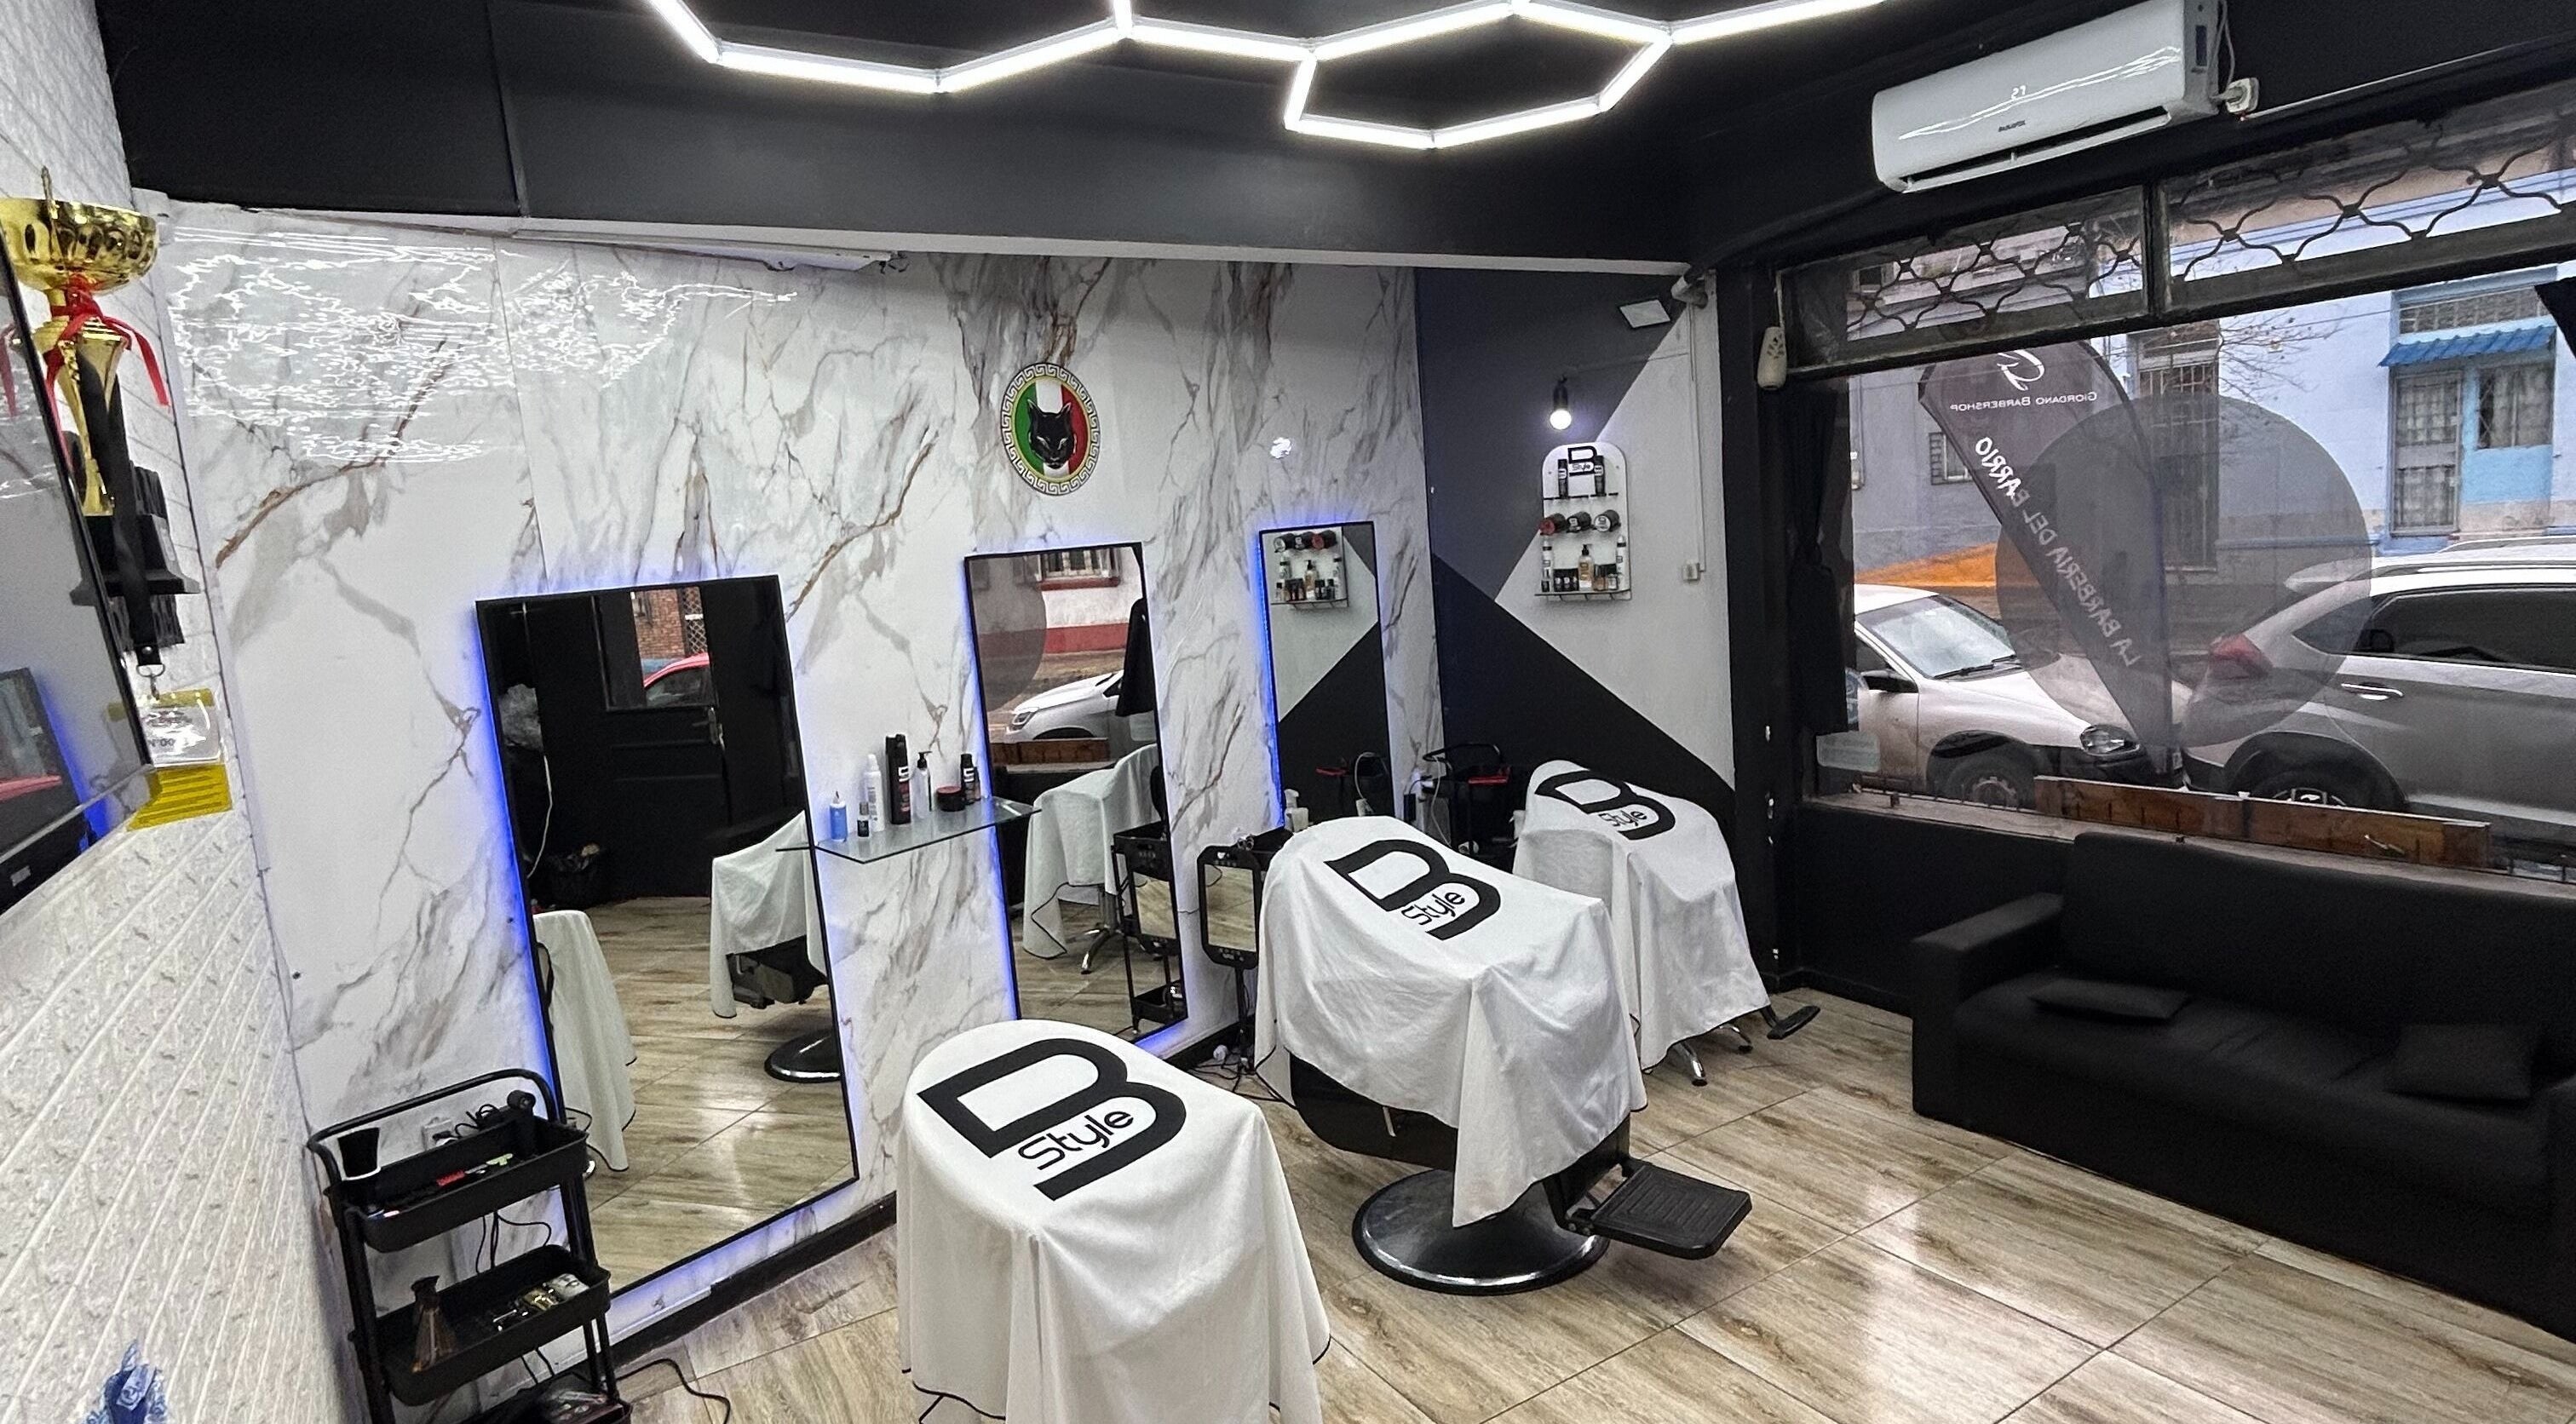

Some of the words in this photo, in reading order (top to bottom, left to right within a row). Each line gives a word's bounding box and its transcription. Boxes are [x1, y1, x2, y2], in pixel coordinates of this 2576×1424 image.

[1598, 810, 1647, 827] Style
[1323, 840, 1501, 941] B
[1401, 892, 1465, 926] Style
[917, 1038, 1187, 1202] B
[1018, 1111, 1134, 1170] Style
